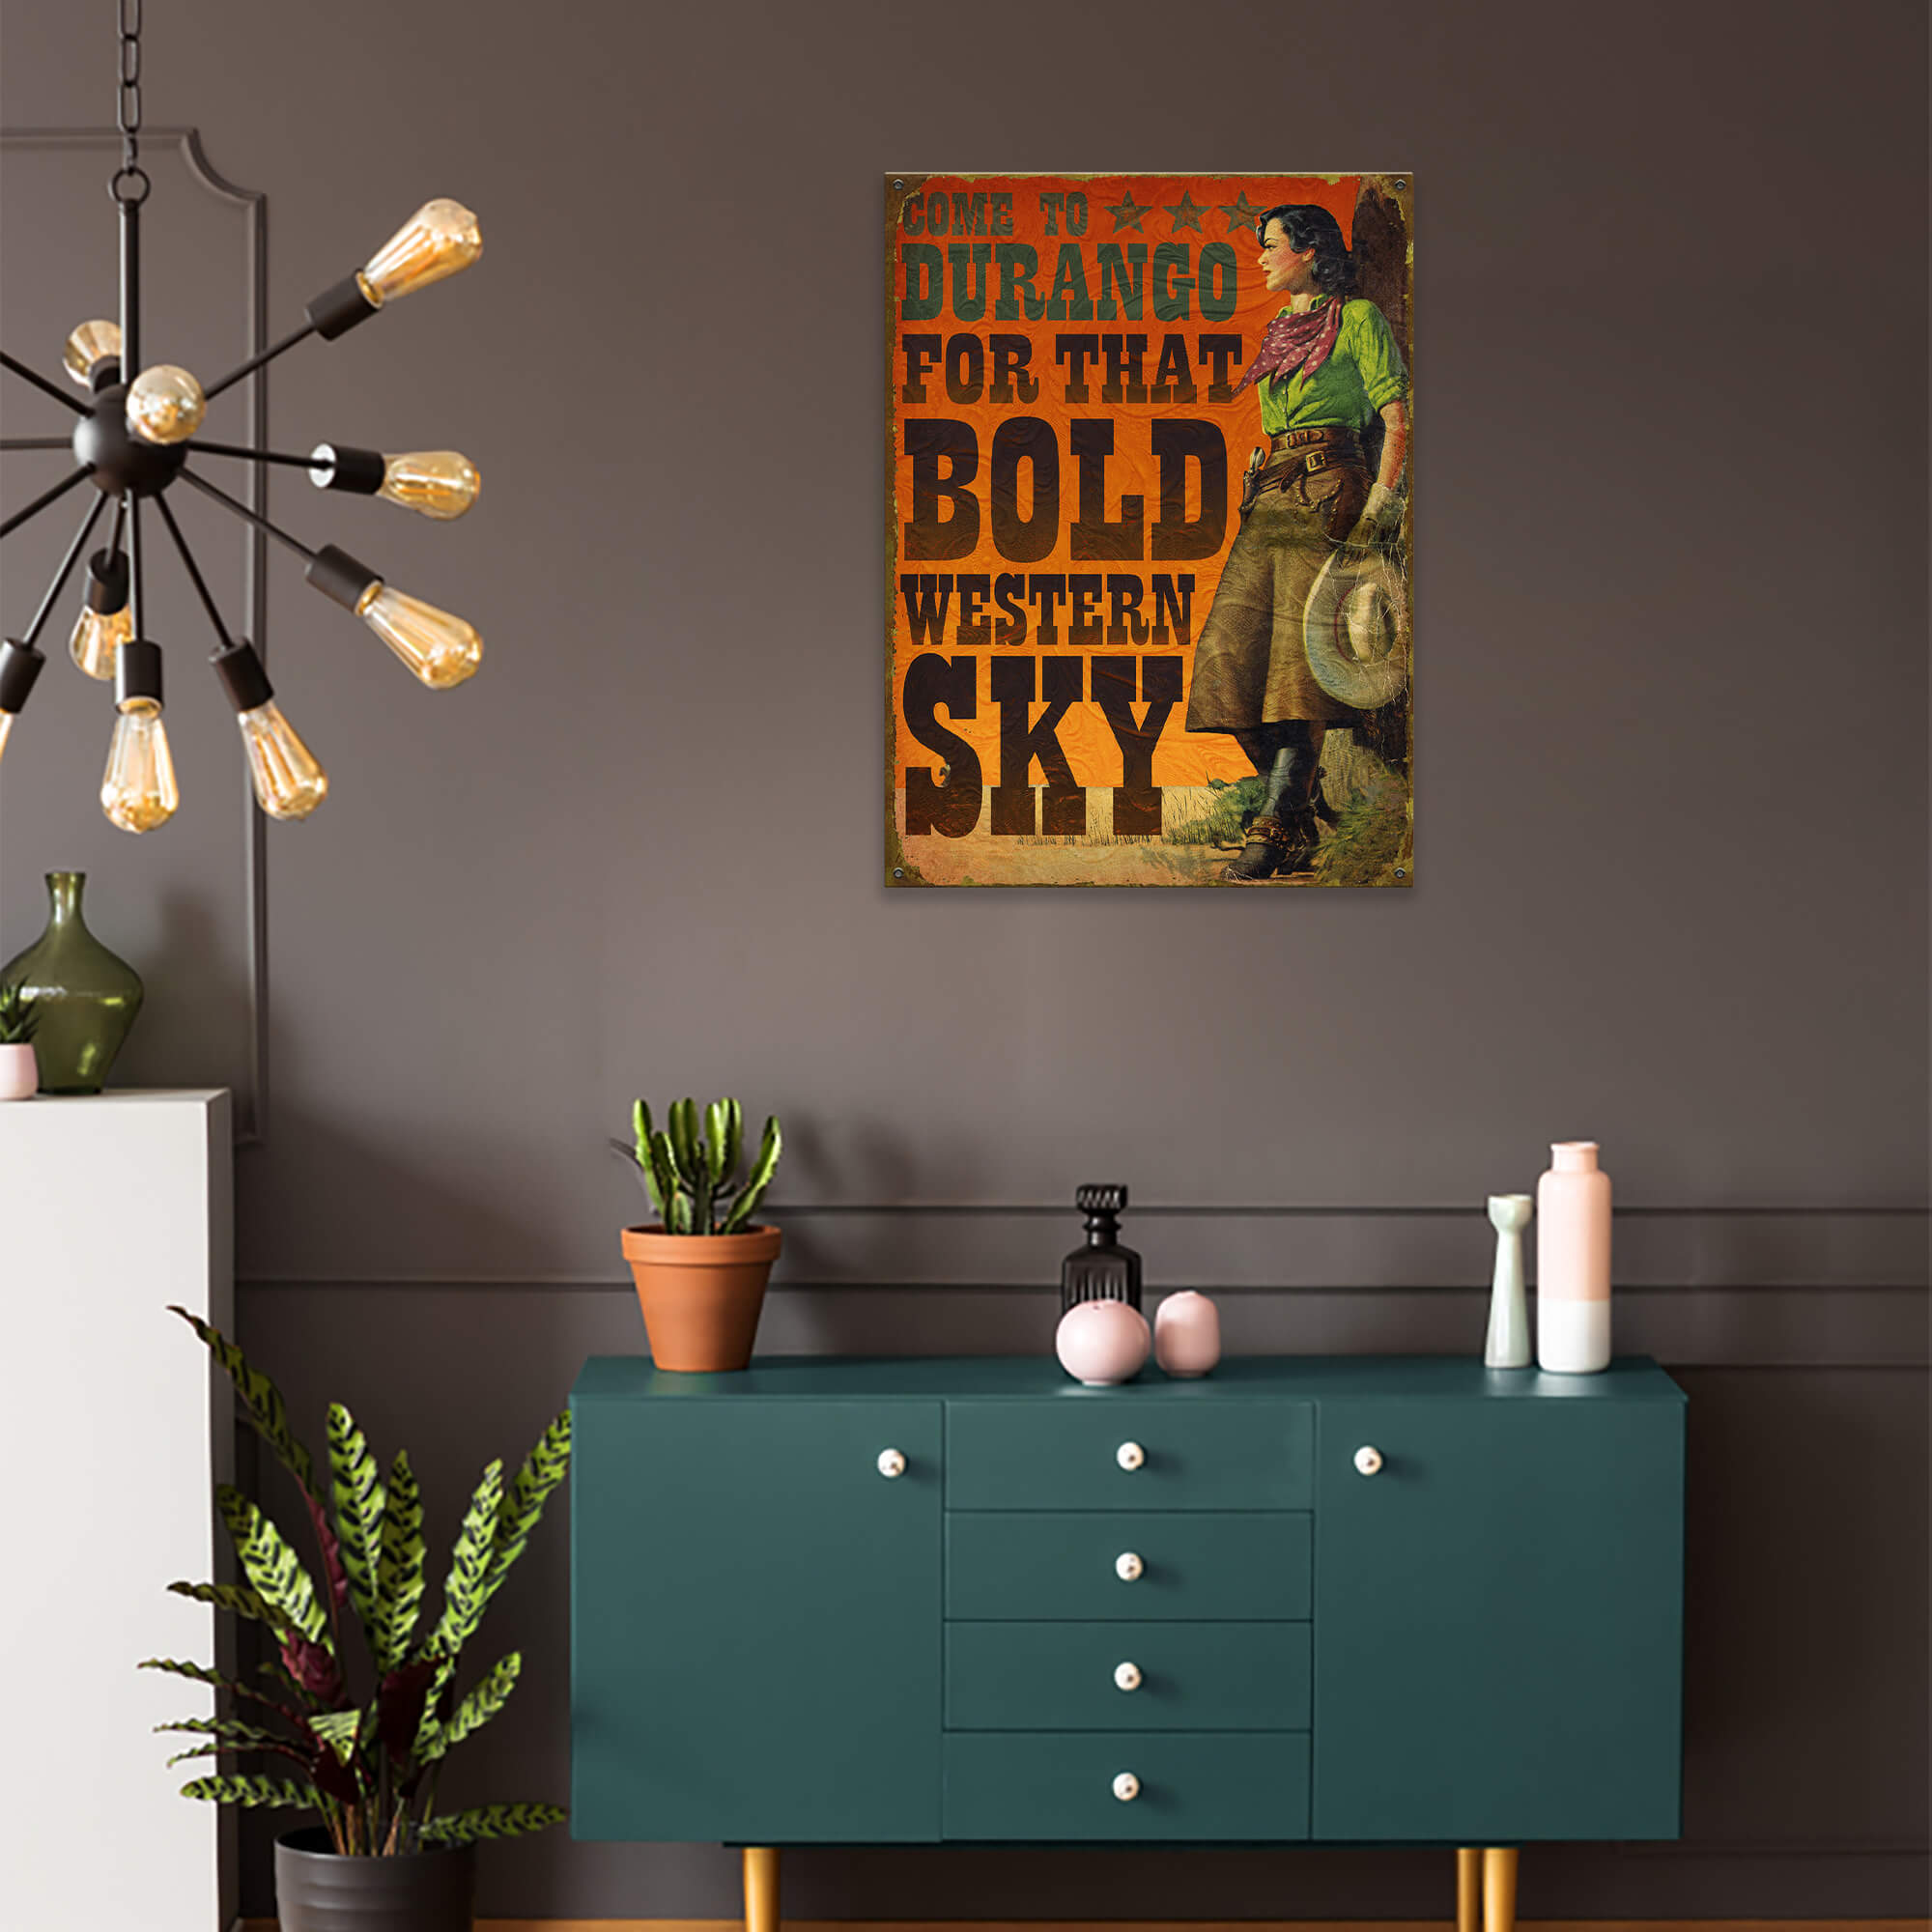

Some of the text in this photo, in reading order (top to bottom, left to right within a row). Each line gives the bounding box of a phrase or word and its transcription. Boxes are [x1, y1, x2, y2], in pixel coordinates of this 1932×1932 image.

[903, 191, 1089, 237] COME TO
[900, 242, 1237, 322] DURANGO
[901, 333, 1242, 404] FOR THAT
[903, 416, 1228, 562] BOLD
[900, 572, 1196, 646] WESTERN
[902, 653, 1183, 838] SKY
